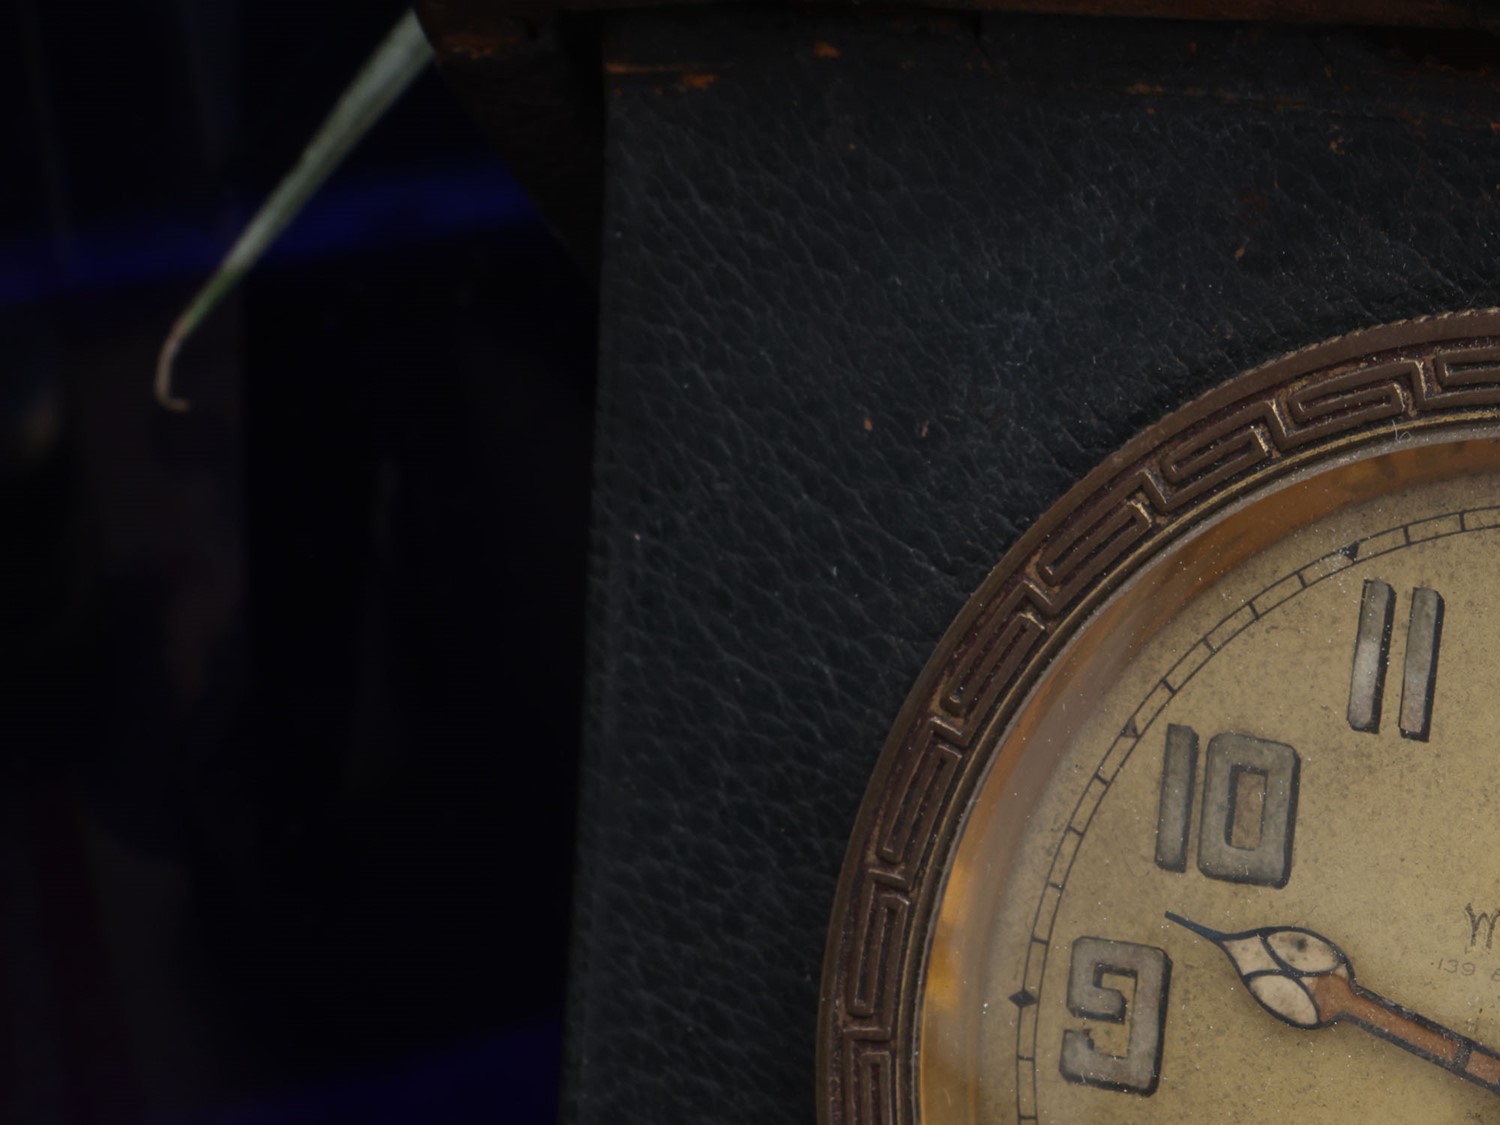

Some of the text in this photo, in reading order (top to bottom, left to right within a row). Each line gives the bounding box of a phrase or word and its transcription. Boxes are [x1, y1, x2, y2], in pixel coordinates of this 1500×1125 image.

[1346, 577, 1445, 743] 11
[1154, 723, 1300, 889] 10
[1059, 935, 1172, 1097] 9
